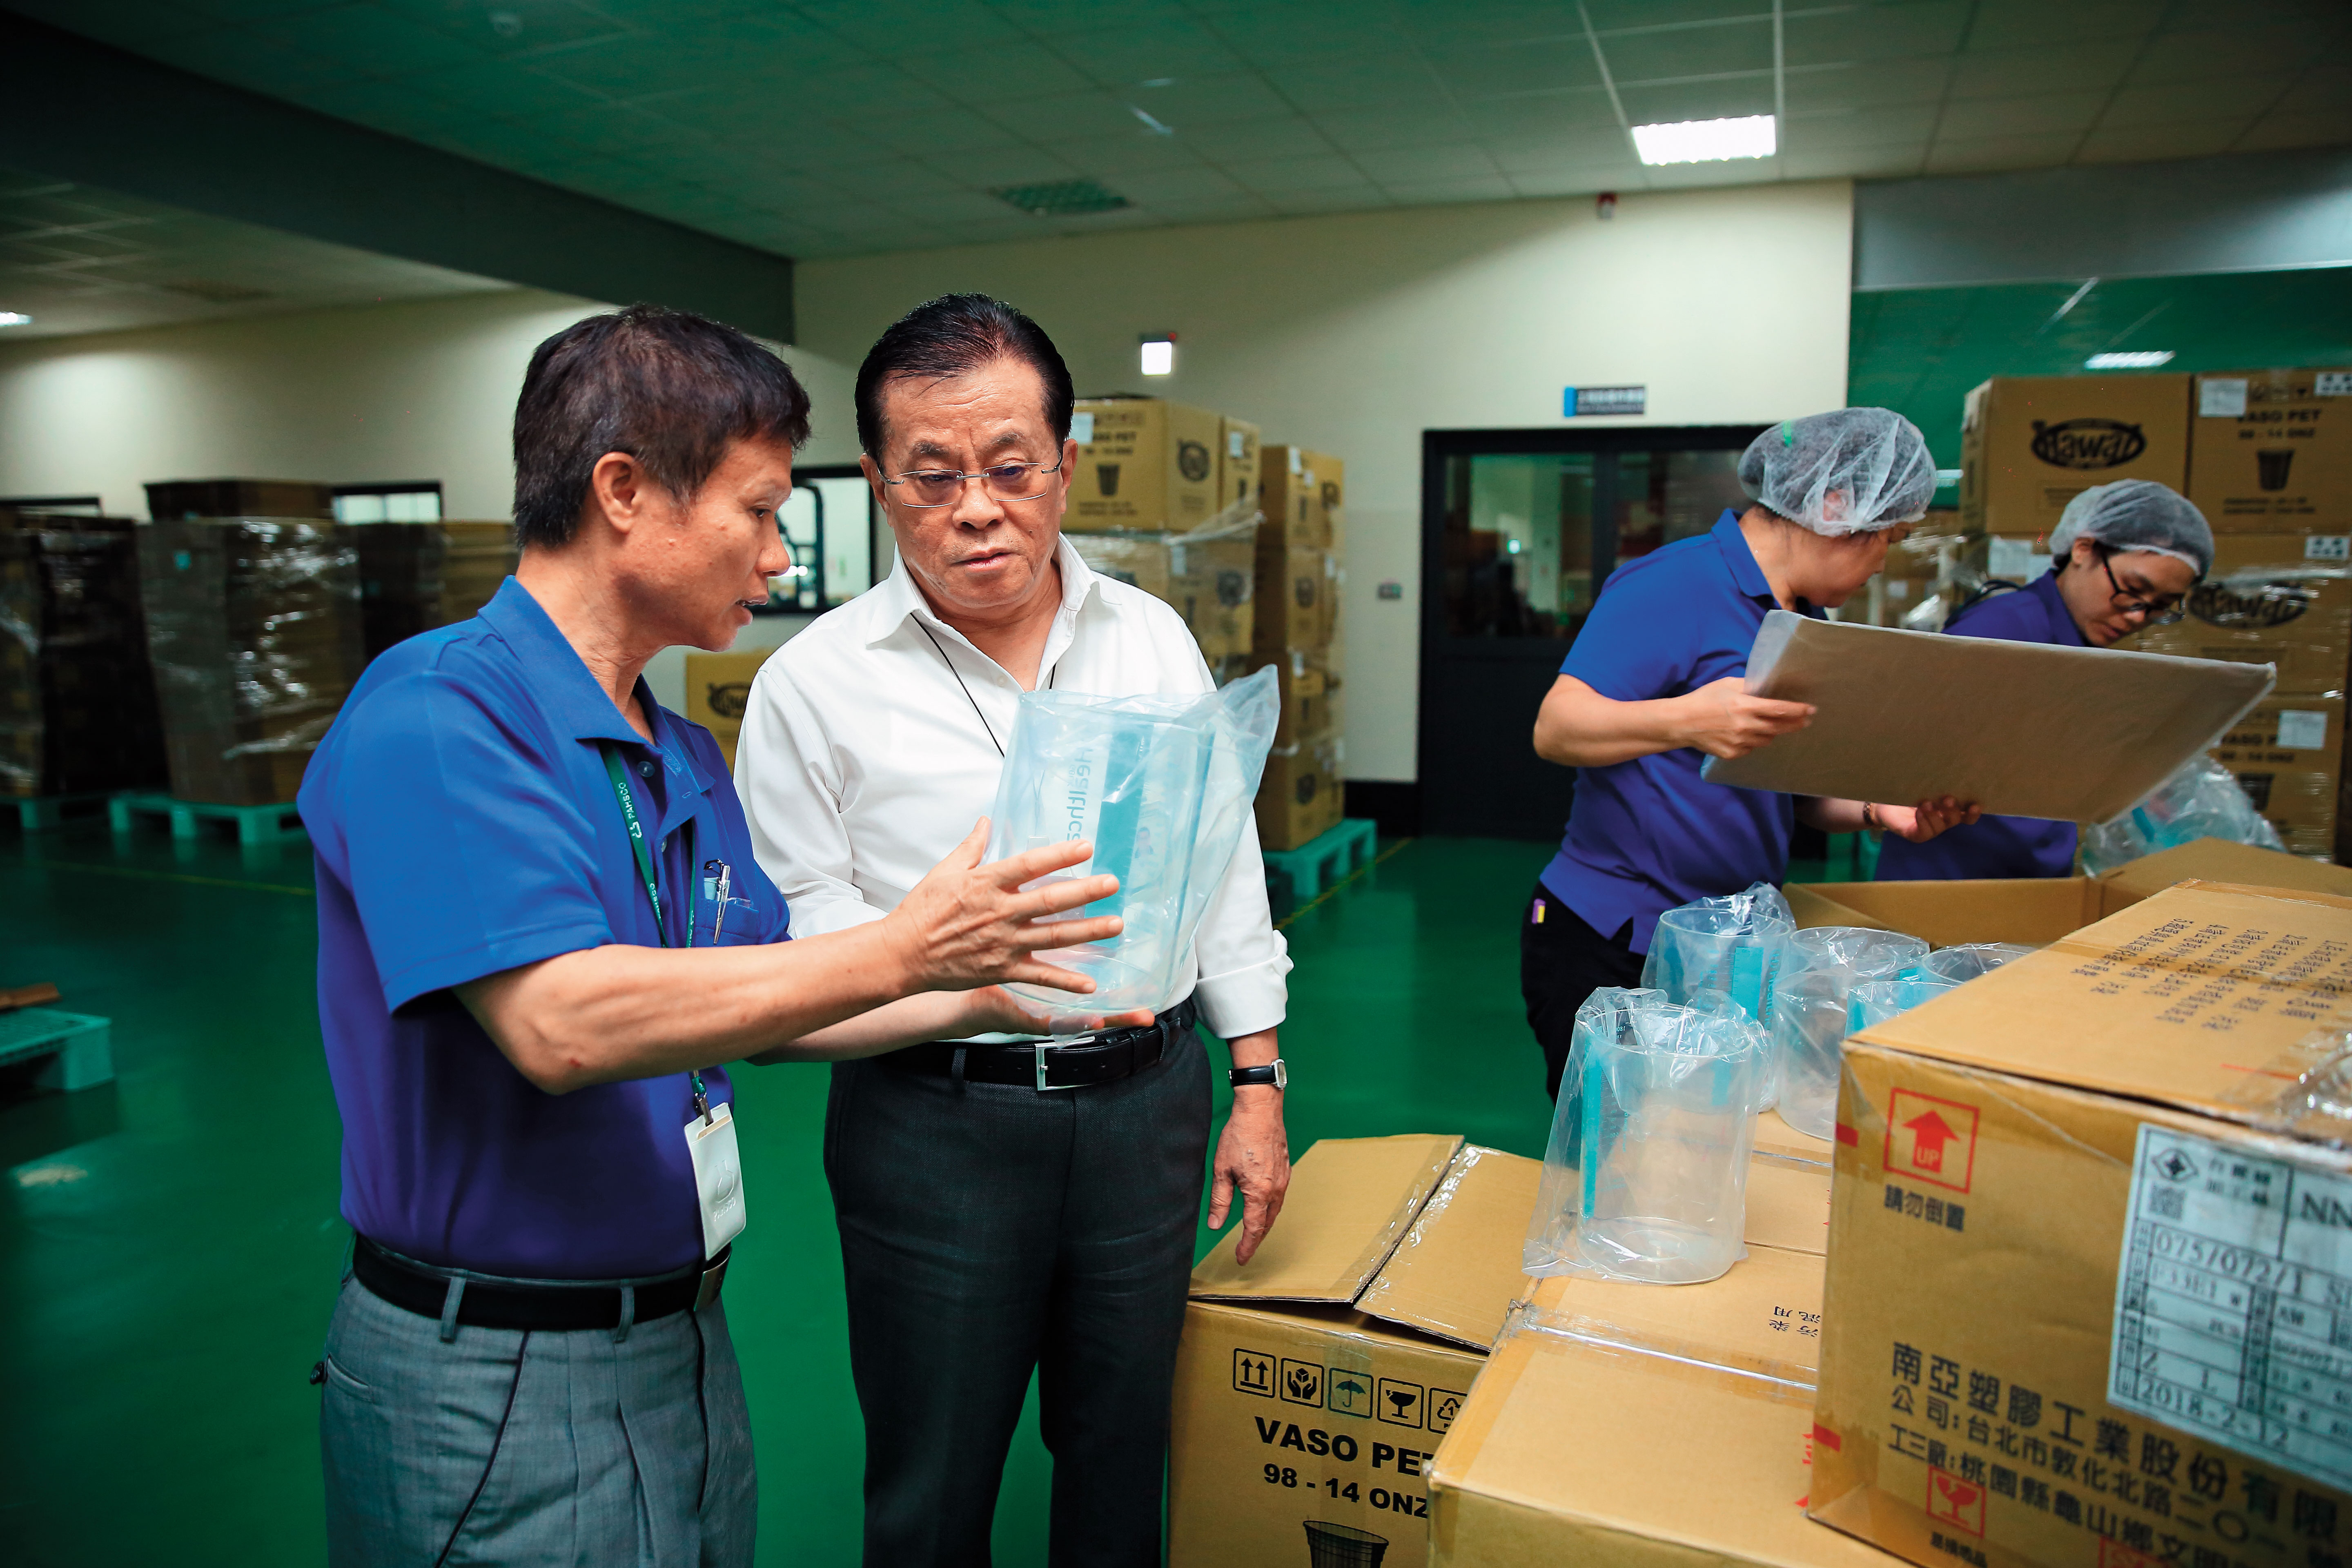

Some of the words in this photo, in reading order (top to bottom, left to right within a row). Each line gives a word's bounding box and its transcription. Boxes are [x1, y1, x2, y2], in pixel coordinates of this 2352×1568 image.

[618, 782, 635, 819] PAHSCO
[1918, 1146, 1940, 1167] UP
[1254, 1416, 1359, 1463] VASO
[1263, 1463, 1298, 1489] 98
[1325, 1478, 1360, 1503] 14
[1369, 1488, 1428, 1519] ONZ
